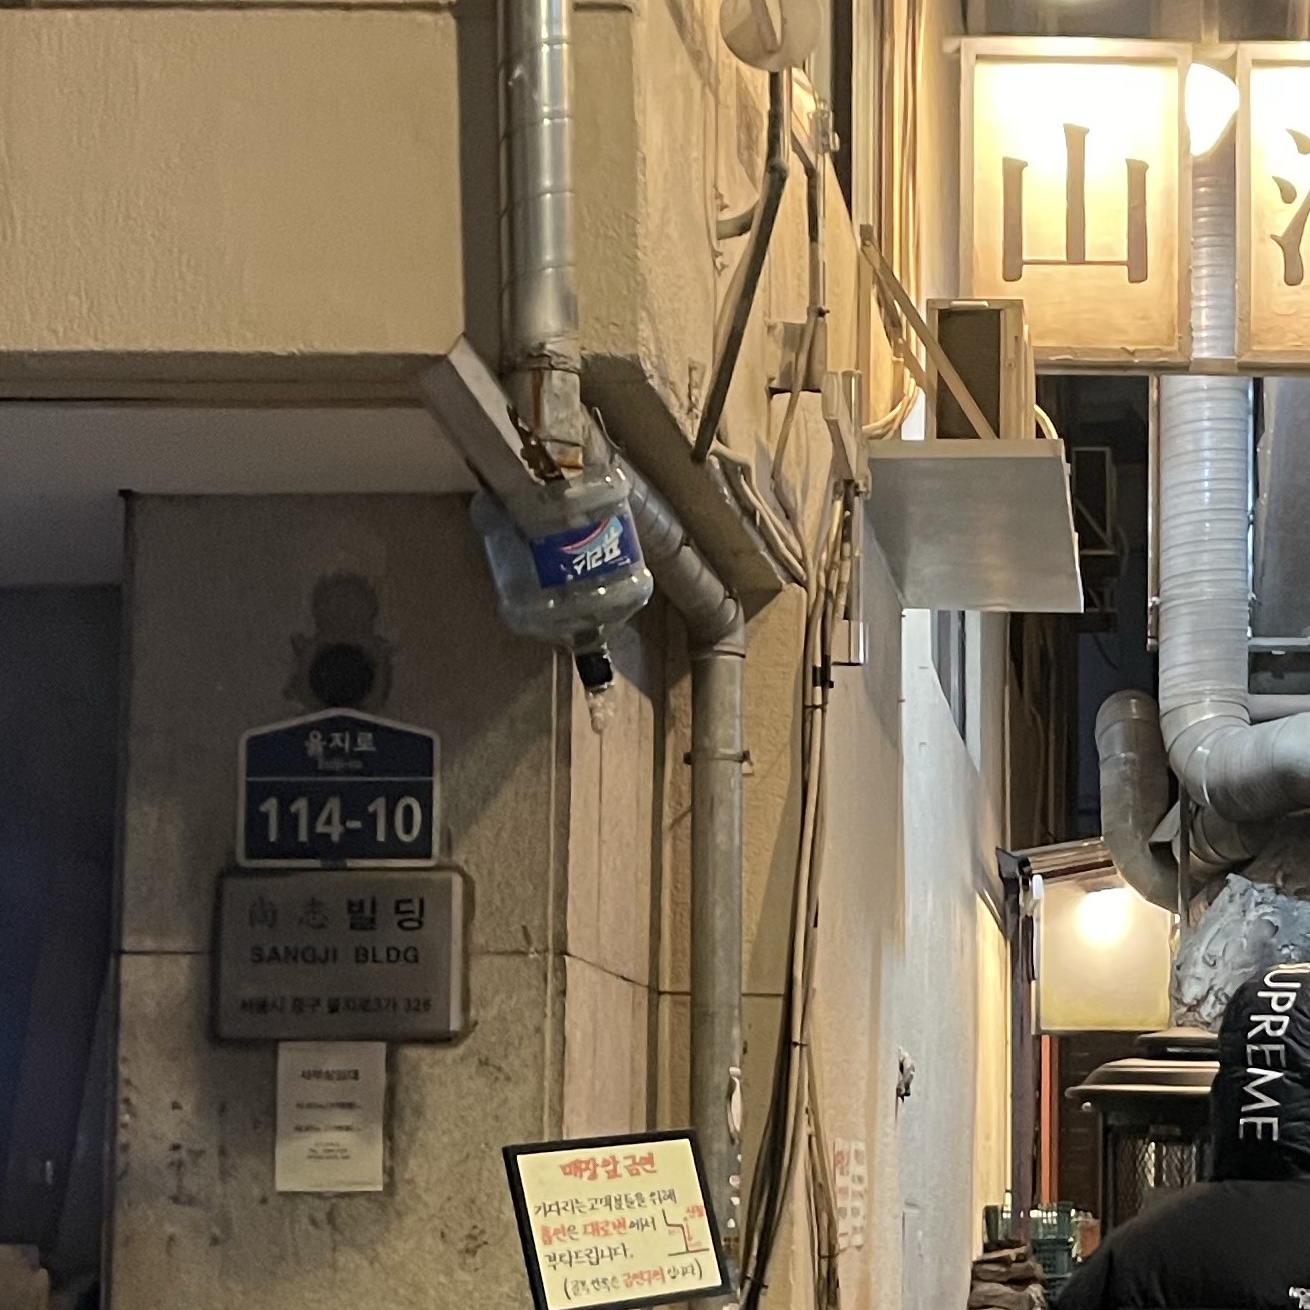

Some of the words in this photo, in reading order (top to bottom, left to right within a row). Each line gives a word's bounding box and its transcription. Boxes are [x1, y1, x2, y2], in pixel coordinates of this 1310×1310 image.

[1002, 122, 1148, 284] 山
[305, 730, 376, 756] 을지로
[259, 797, 422, 842] 114-10
[347, 896, 425, 930] 빌딩
[250, 946, 338, 964] SANGJI
[355, 946, 419, 963] BLDG
[1239, 963, 1303, 1141] UPREME
